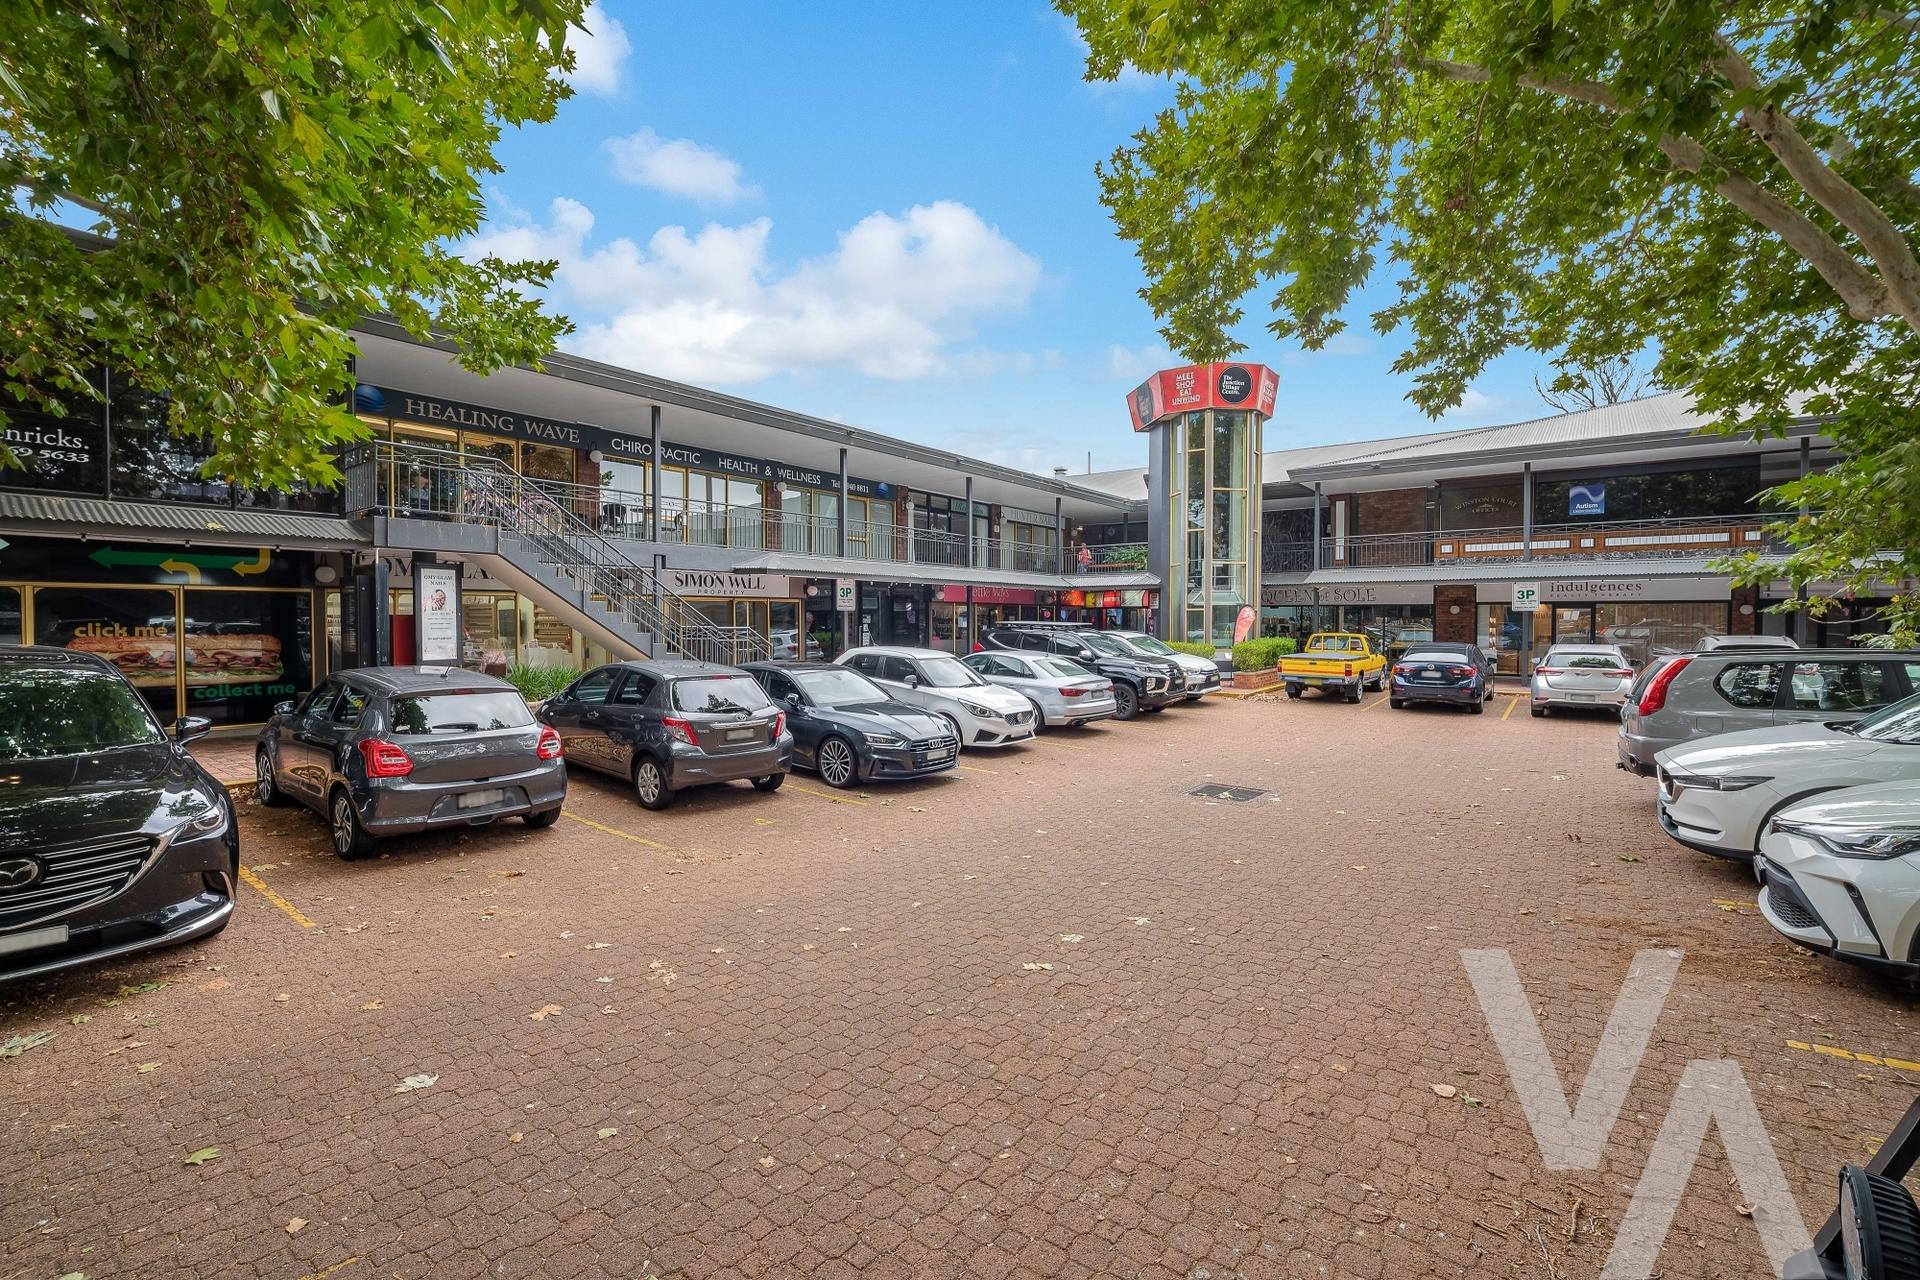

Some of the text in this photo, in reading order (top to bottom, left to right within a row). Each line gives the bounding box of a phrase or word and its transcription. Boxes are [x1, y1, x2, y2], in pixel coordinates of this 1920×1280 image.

[1176, 372, 1194, 381] MEET
[1176, 380, 1195, 389] SHOP
[1180, 388, 1192, 396] EAT
[1171, 395, 1200, 405] UNWIND
[404, 399, 580, 443] HEALING WAVE
[38, 450, 89, 463] 5633
[611, 438, 700, 464] CHIRORACTIC
[718, 457, 758, 474] HEALTH
[765, 466, 772, 476] &
[776, 467, 821, 485] WELLNESS
[675, 573, 725, 589] SIMON
[1551, 581, 1642, 593] indulgences
[840, 588, 852, 597] 3P
[1334, 587, 1377, 602] SOLE
[1517, 590, 1535, 599] 3P
[73, 623, 168, 637] click me
[194, 682, 295, 699] collect me
